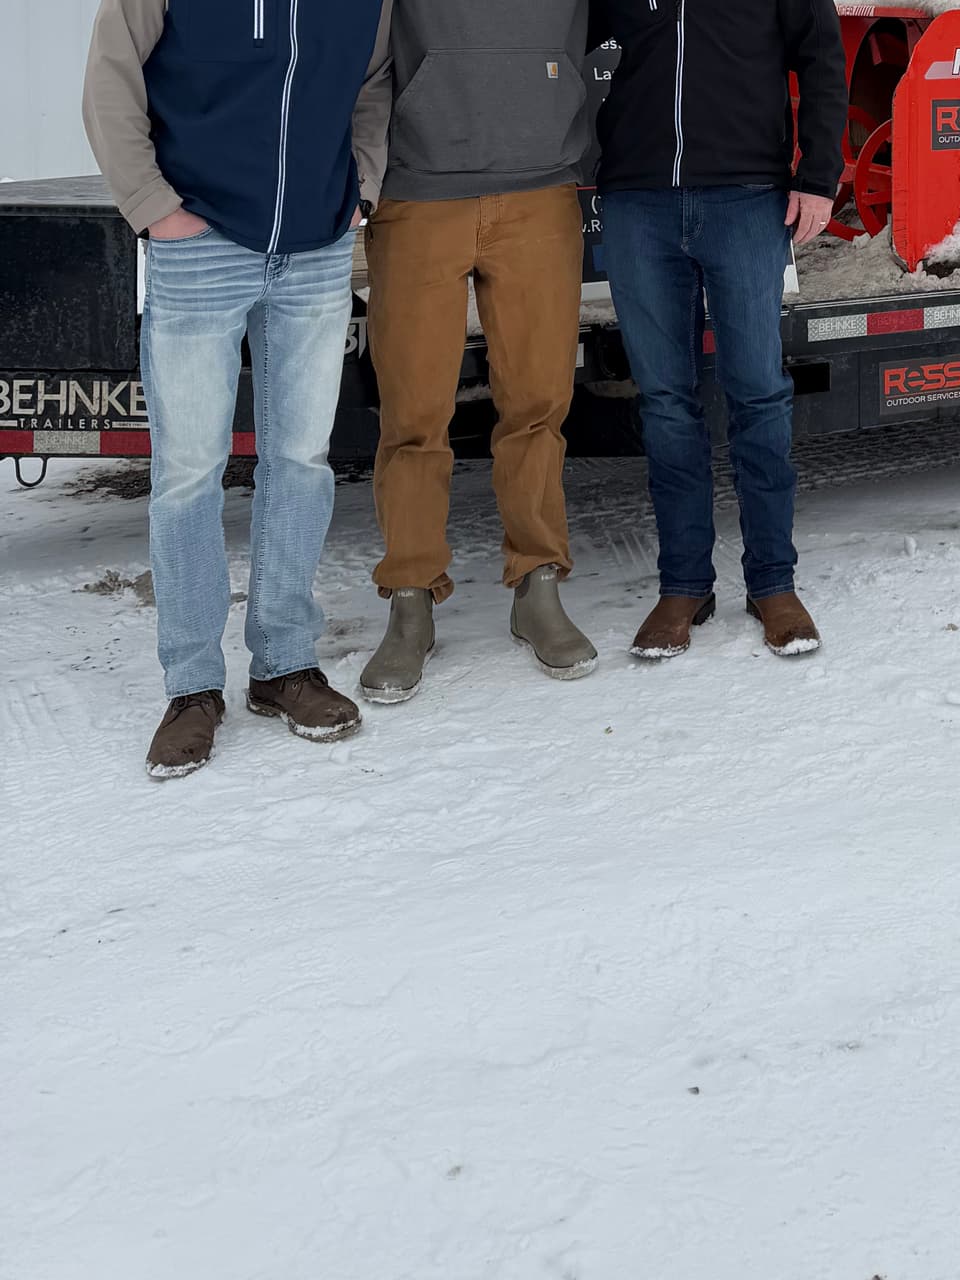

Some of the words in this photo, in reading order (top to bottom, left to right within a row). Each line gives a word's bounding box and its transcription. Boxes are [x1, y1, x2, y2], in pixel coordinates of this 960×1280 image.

[818, 320, 857, 334] BEHNKE
[886, 394, 926, 408] OUTDOOR
[19, 418, 111, 430] TRAILERS
